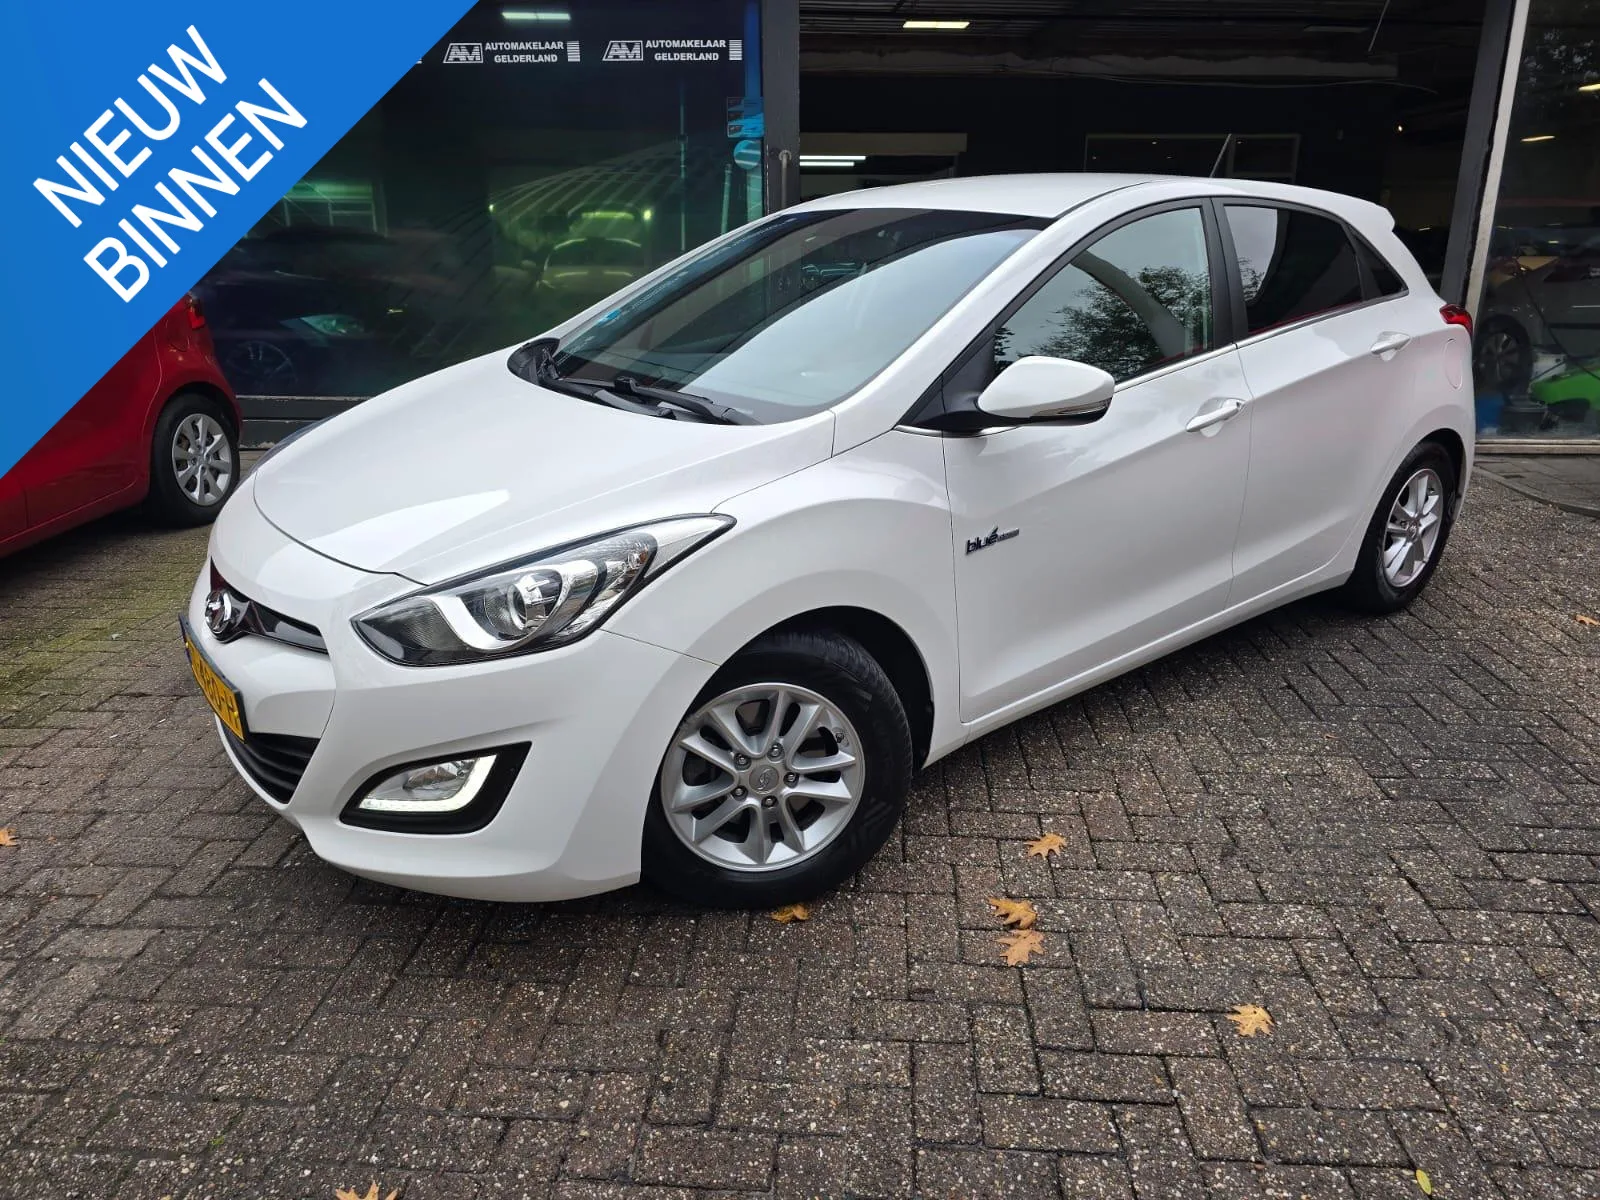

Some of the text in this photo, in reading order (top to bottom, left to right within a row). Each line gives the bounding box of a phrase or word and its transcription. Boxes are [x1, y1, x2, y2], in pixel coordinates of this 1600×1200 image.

[484, 41, 565, 51] AUTOMAKELAAR
[645, 39, 727, 49] AUTOMAKELAAR
[446, 45, 481, 61] AM
[606, 42, 641, 59] AM
[493, 54, 558, 63] GELDERLAND
[654, 52, 720, 61] GELDERLAND
